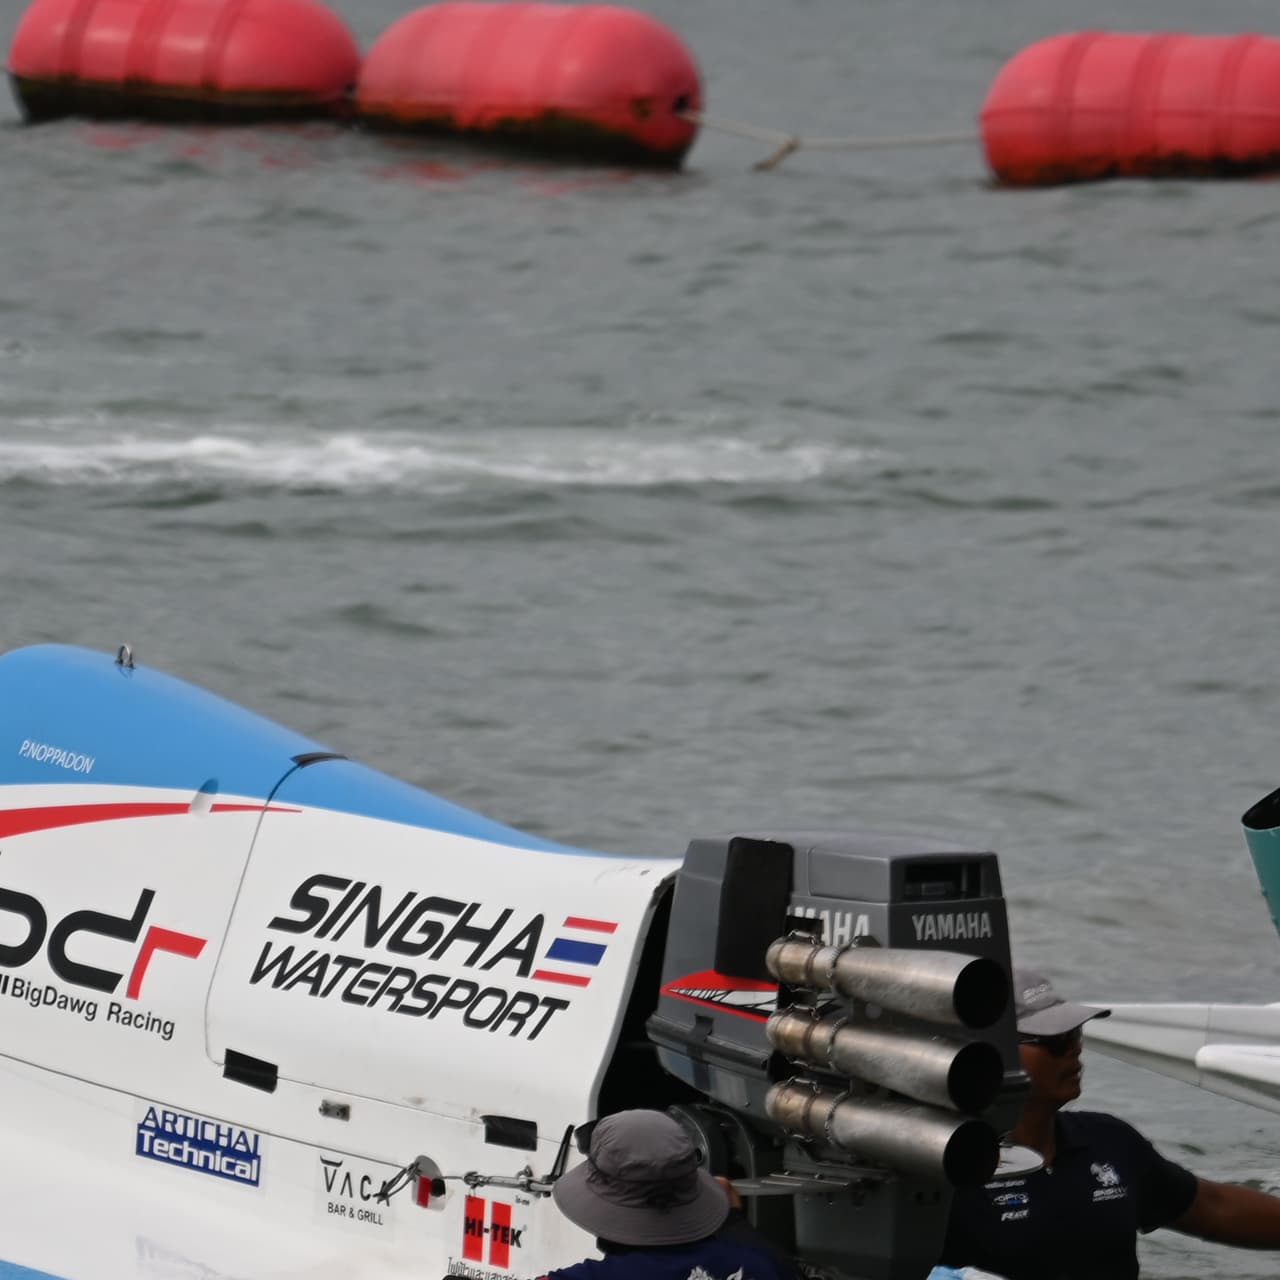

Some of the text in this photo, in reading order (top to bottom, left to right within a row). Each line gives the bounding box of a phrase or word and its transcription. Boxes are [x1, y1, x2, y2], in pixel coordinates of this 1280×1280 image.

[19, 739, 95, 774] P.NOPPADON
[266, 873, 545, 979] SINGHA
[911, 911, 993, 941] YAMAHA
[10, 977, 176, 1041] BigDawg Racing
[249, 940, 571, 1041] WATERSPORT
[141, 1105, 261, 1155] ARTICHAI
[139, 1129, 258, 1182] Technical
[327, 1202, 384, 1226] BAR & GRILL
[464, 1216, 522, 1249] HI-TEK
